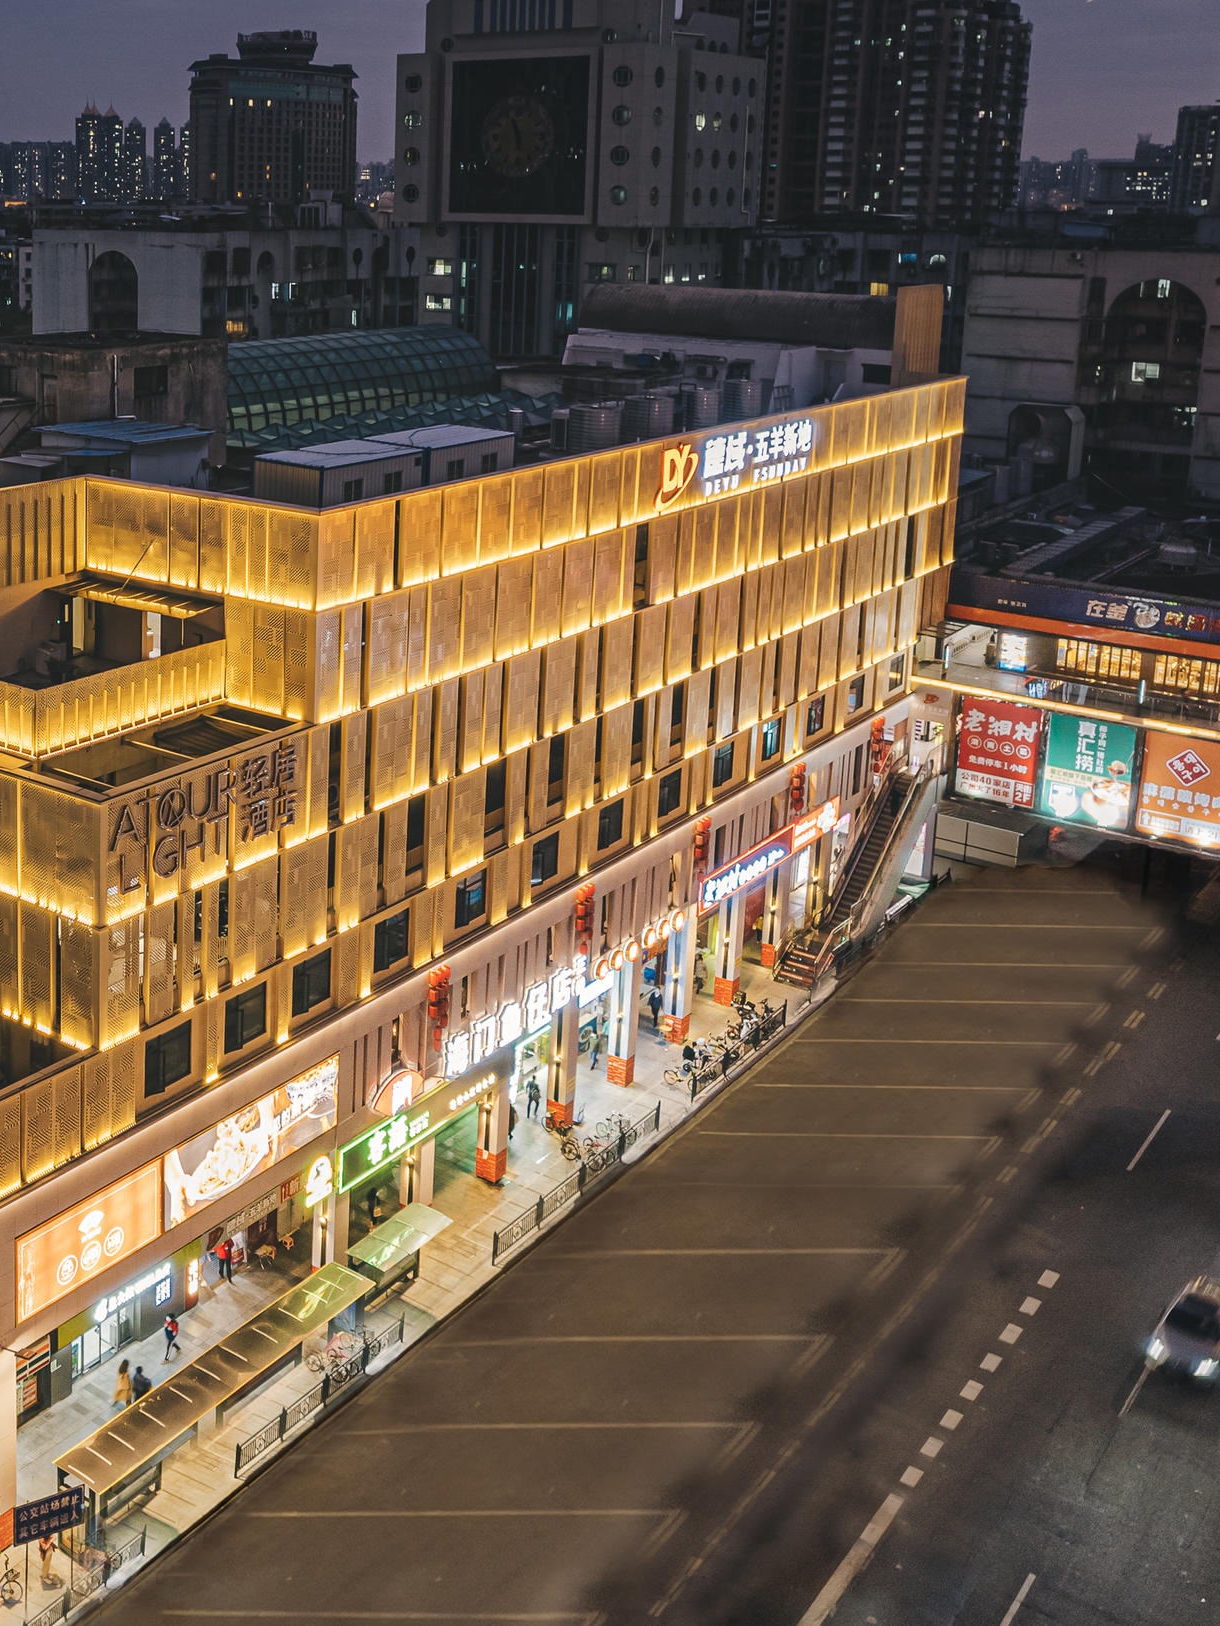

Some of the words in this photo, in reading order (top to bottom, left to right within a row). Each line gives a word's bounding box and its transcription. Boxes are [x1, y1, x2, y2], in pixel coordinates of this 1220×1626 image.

[964, 708, 1038, 743] 老湘村
[1075, 721, 1097, 773] 真汇捞
[109, 768, 237, 852] ATOUR
[1014, 791, 1031, 803] 2F
[120, 812, 230, 895] LIGHT
[242, 789, 298, 843] 酒店
